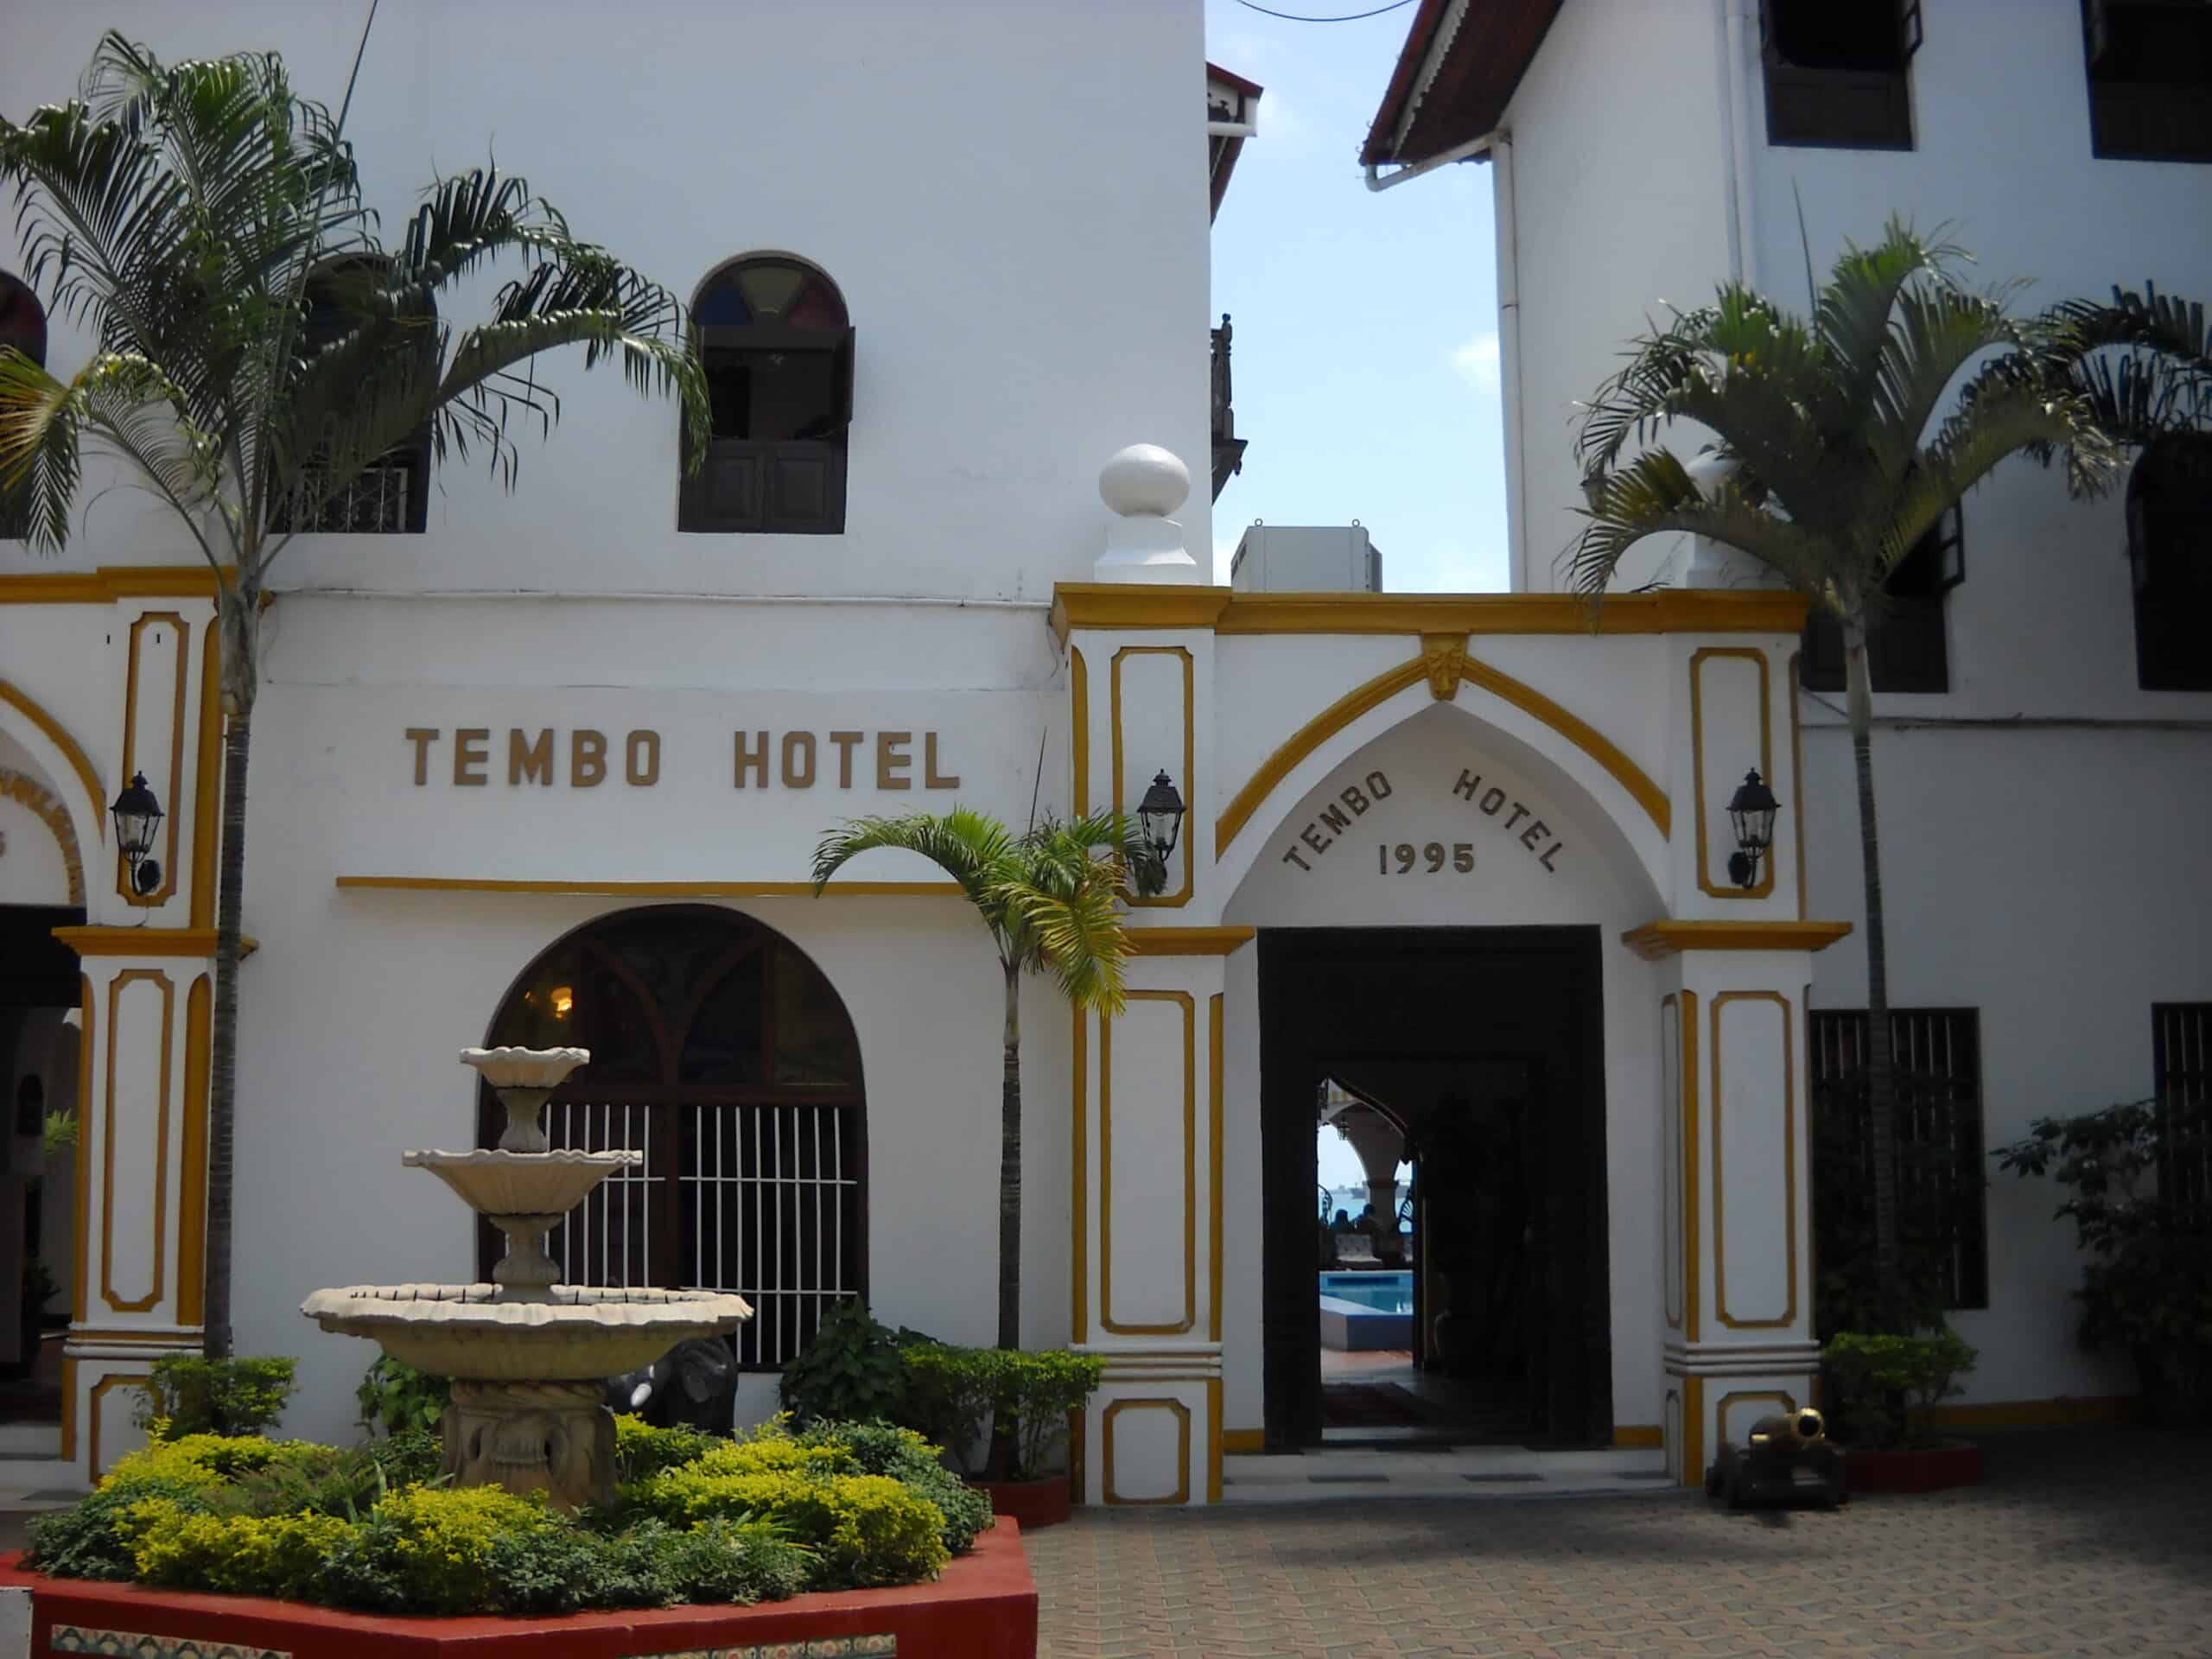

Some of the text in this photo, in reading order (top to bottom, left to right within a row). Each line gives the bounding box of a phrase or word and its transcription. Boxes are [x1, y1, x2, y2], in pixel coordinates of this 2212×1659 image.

[405, 728, 961, 790] TEMBO HOTEL
[1282, 768, 1564, 873] TEMBO HOTEL
[1379, 842, 1475, 875] 1995
